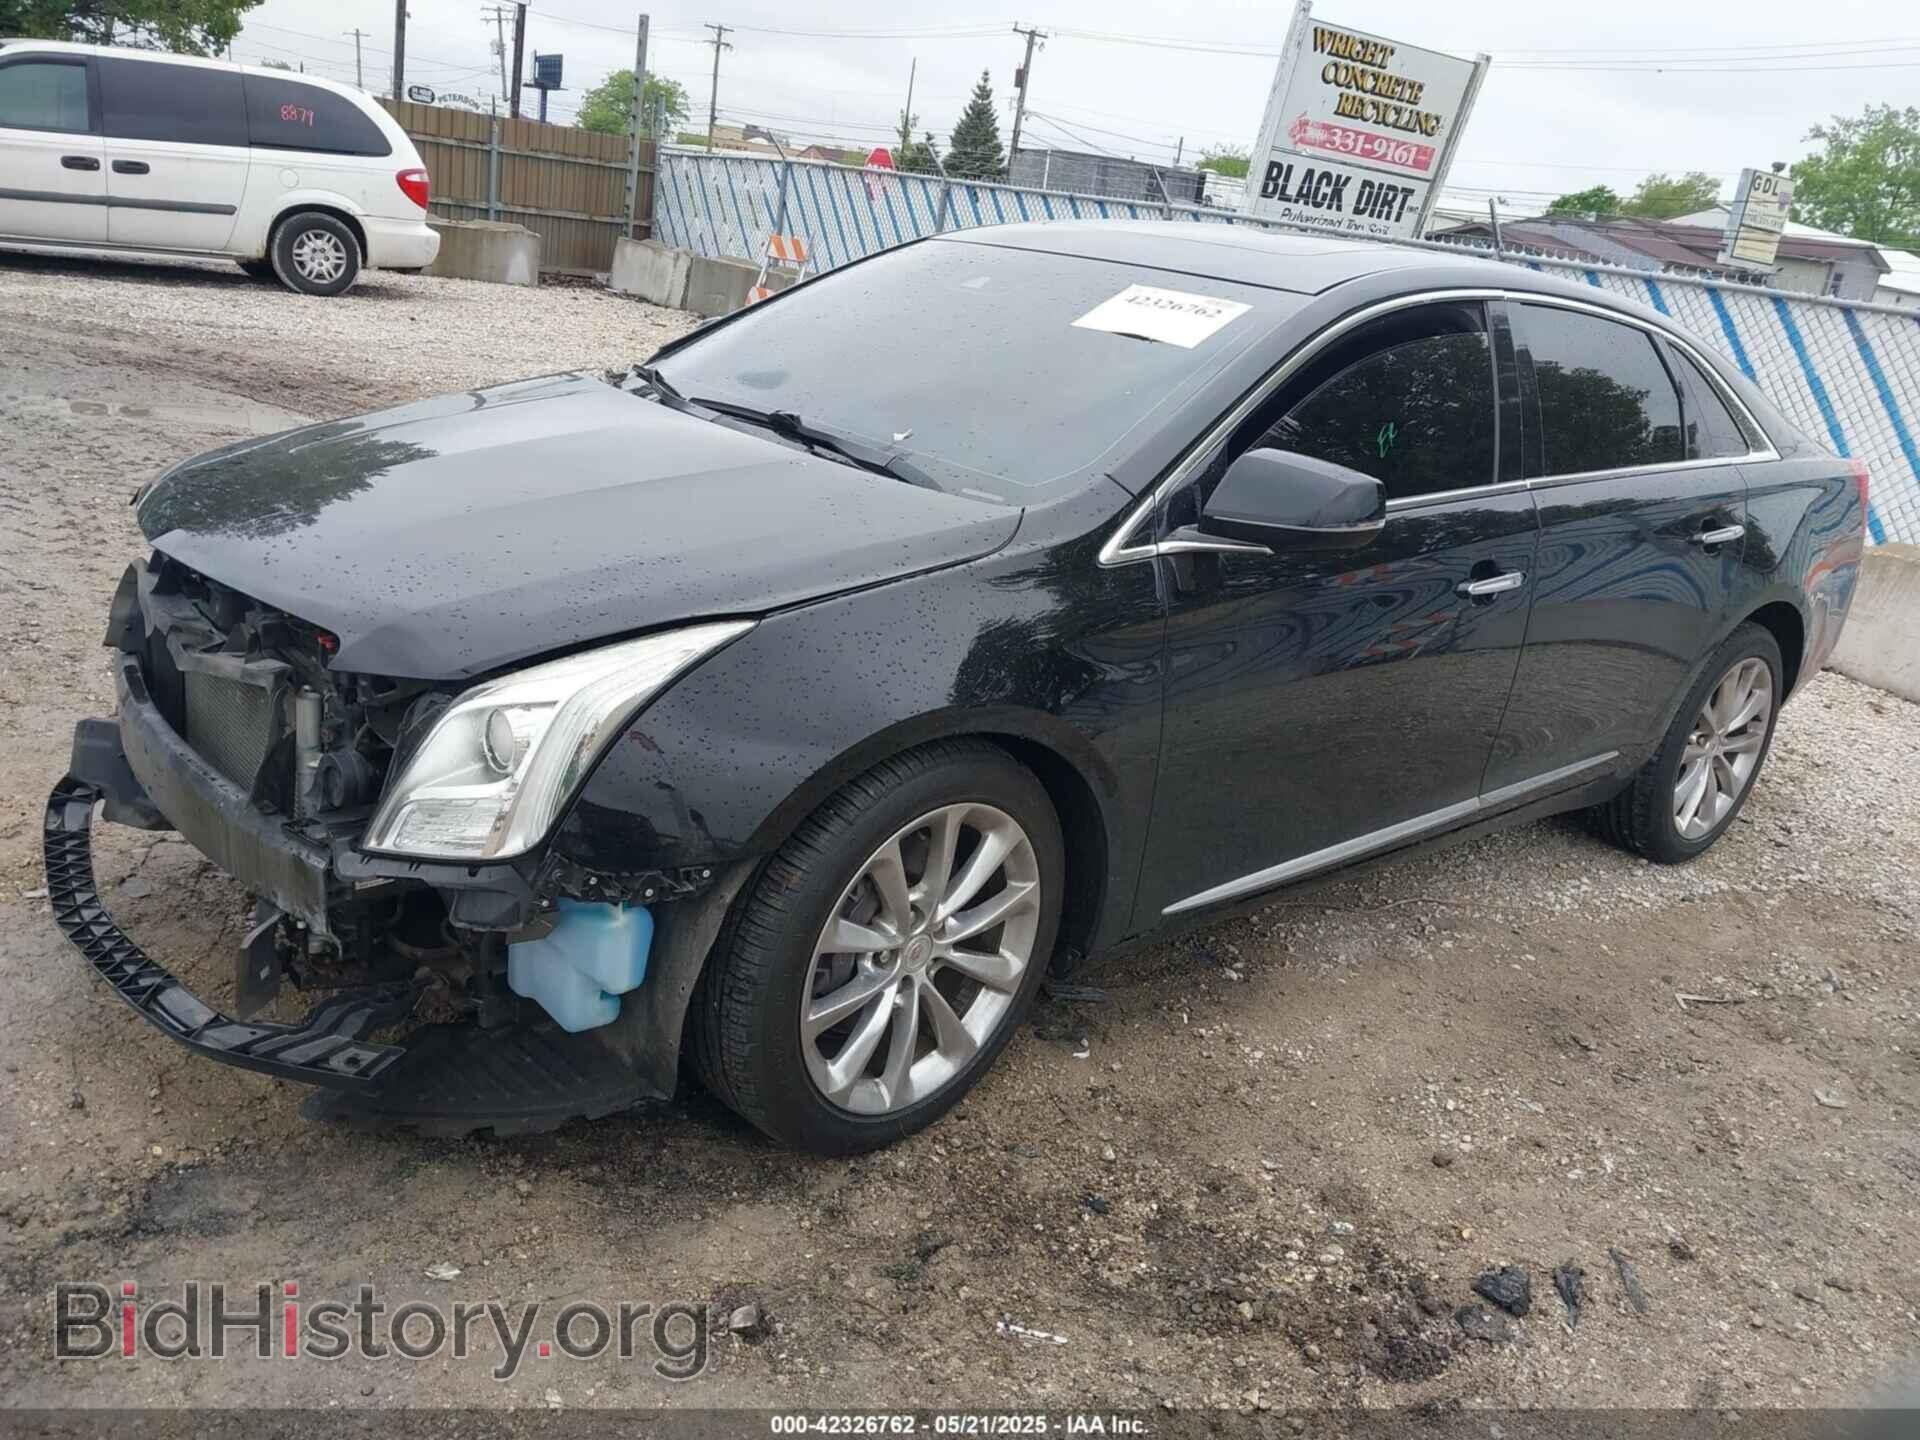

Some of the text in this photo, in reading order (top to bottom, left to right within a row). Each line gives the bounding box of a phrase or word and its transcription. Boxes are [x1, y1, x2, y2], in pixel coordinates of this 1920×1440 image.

[1312, 26, 1396, 70] WRIGHT
[1321, 61, 1425, 106] CONCRETE
[280, 104, 314, 128] 8879
[1333, 92, 1441, 137] RECYCLING
[1260, 160, 1352, 213] BLACK
[1352, 178, 1415, 223] DIRT
[1753, 174, 1780, 196] GDL
